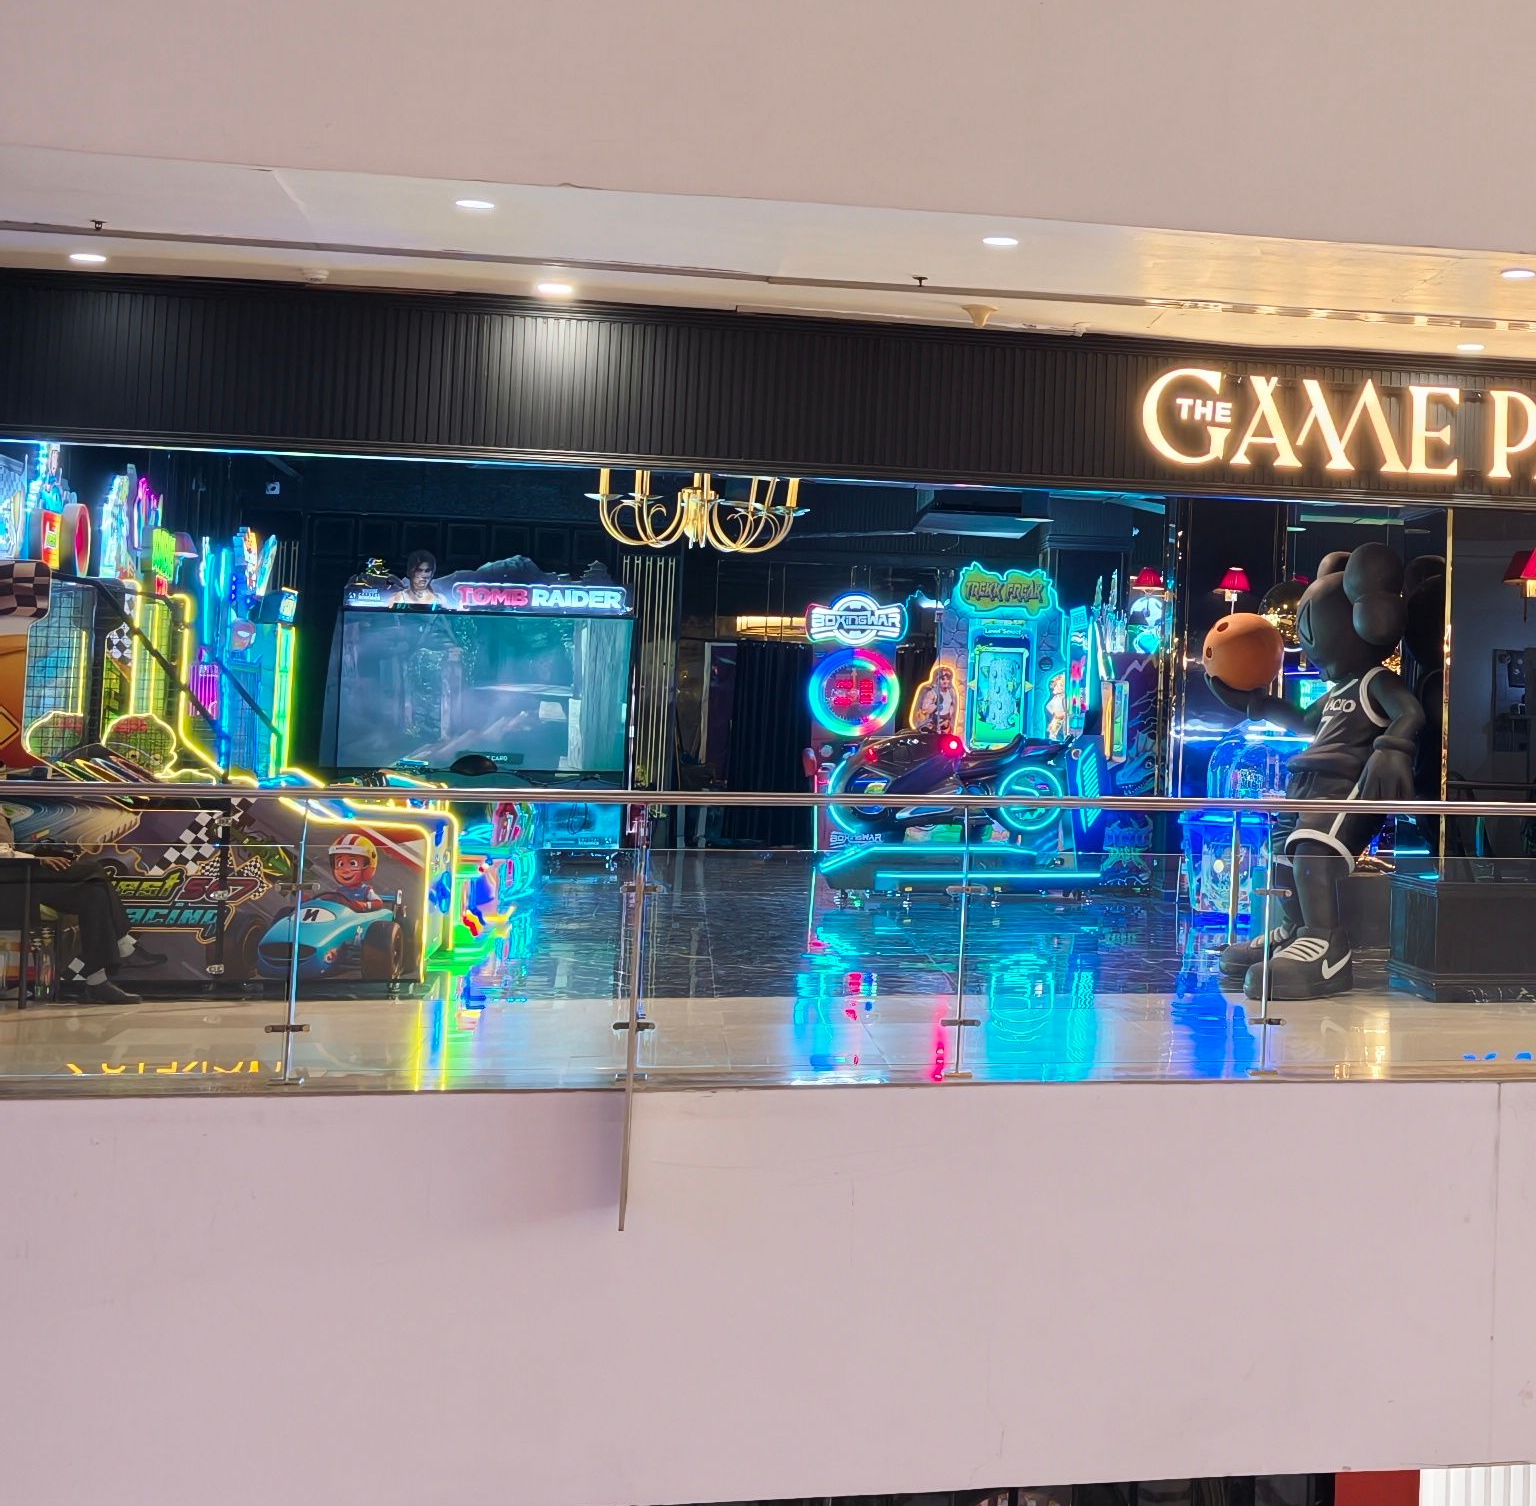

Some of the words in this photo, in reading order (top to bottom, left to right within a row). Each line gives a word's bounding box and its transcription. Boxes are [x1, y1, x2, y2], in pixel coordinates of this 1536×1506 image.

[1141, 367, 1461, 477] GAME
[1176, 397, 1232, 424] THE
[457, 585, 528, 607] TOMB
[532, 587, 622, 609] RAIDER
